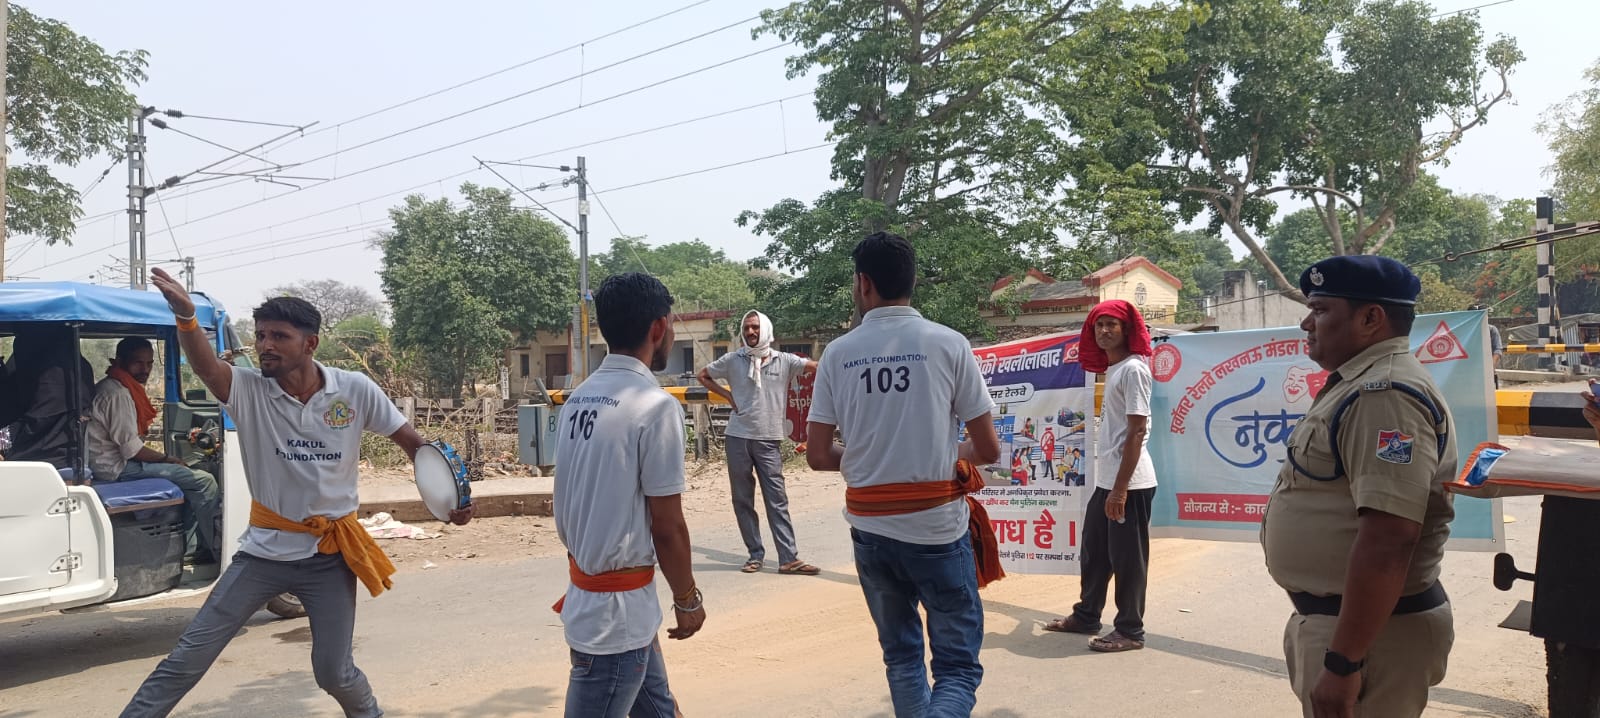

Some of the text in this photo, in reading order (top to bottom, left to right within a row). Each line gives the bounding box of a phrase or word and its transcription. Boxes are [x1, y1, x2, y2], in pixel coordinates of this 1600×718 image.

[843, 353, 928, 370] KAKUL FOUNDATION
[997, 348, 1062, 374] खलीलाबाद
[1185, 370, 1217, 400] रेलवे
[1211, 346, 1263, 380] लखनऊ
[1263, 338, 1300, 358] मंडल
[860, 366, 910, 393] 103
[1004, 385, 1027, 399] रेलवे
[287, 439, 326, 449] KAKUL
[1219, 499, 1229, 514] से
[1032, 508, 1056, 549] है
